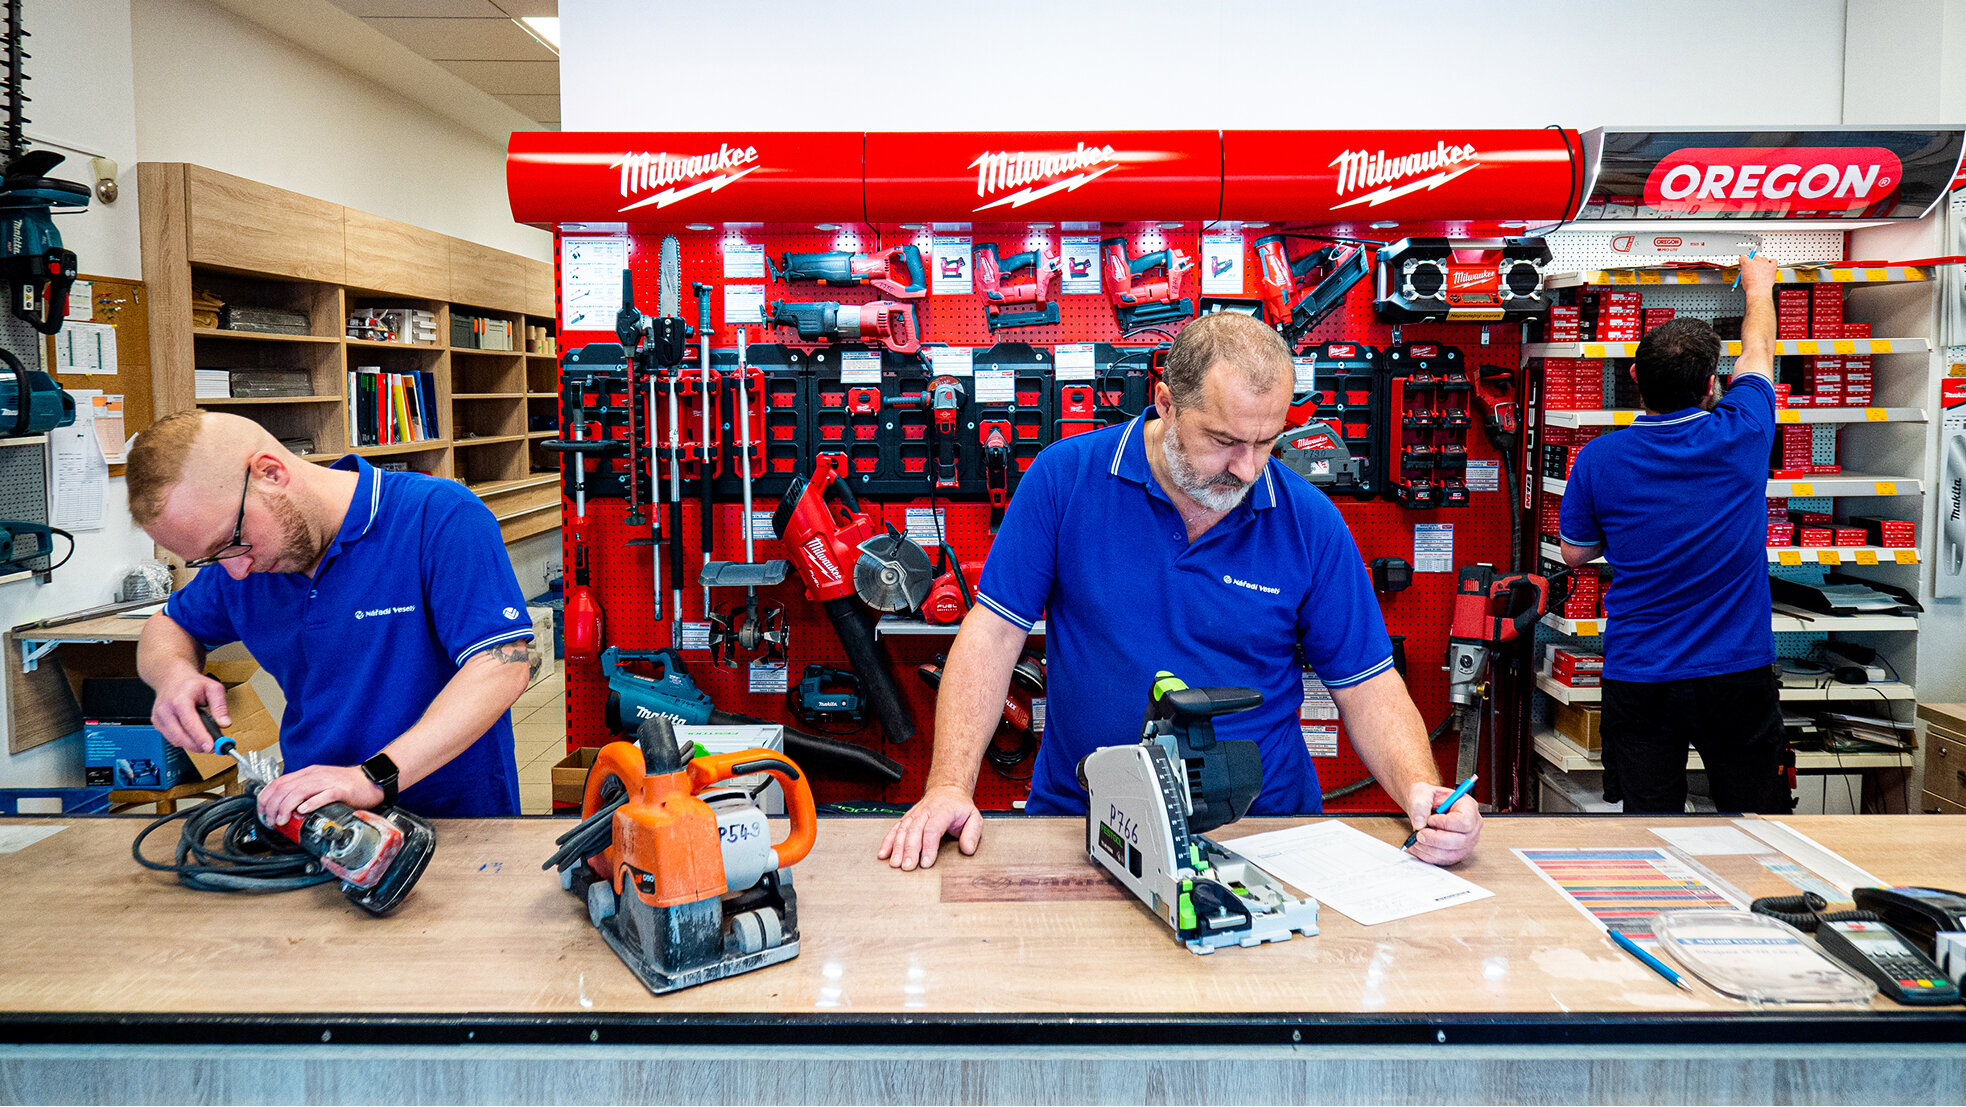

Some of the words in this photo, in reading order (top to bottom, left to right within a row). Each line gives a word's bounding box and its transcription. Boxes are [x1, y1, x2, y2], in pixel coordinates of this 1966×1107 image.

[609, 143, 759, 198] Milwaukee
[967, 142, 1115, 198] Milwaukee
[1328, 140, 1478, 196] Milwaukee
[1660, 164, 1880, 199] OREGON
[1453, 269, 1495, 285] Milwaukee
[1526, 387, 1536, 471] FUEL
[806, 536, 842, 580] Milwaukee
[1101, 823, 1123, 849] FESTOOL
[1110, 803, 1138, 844] P766
